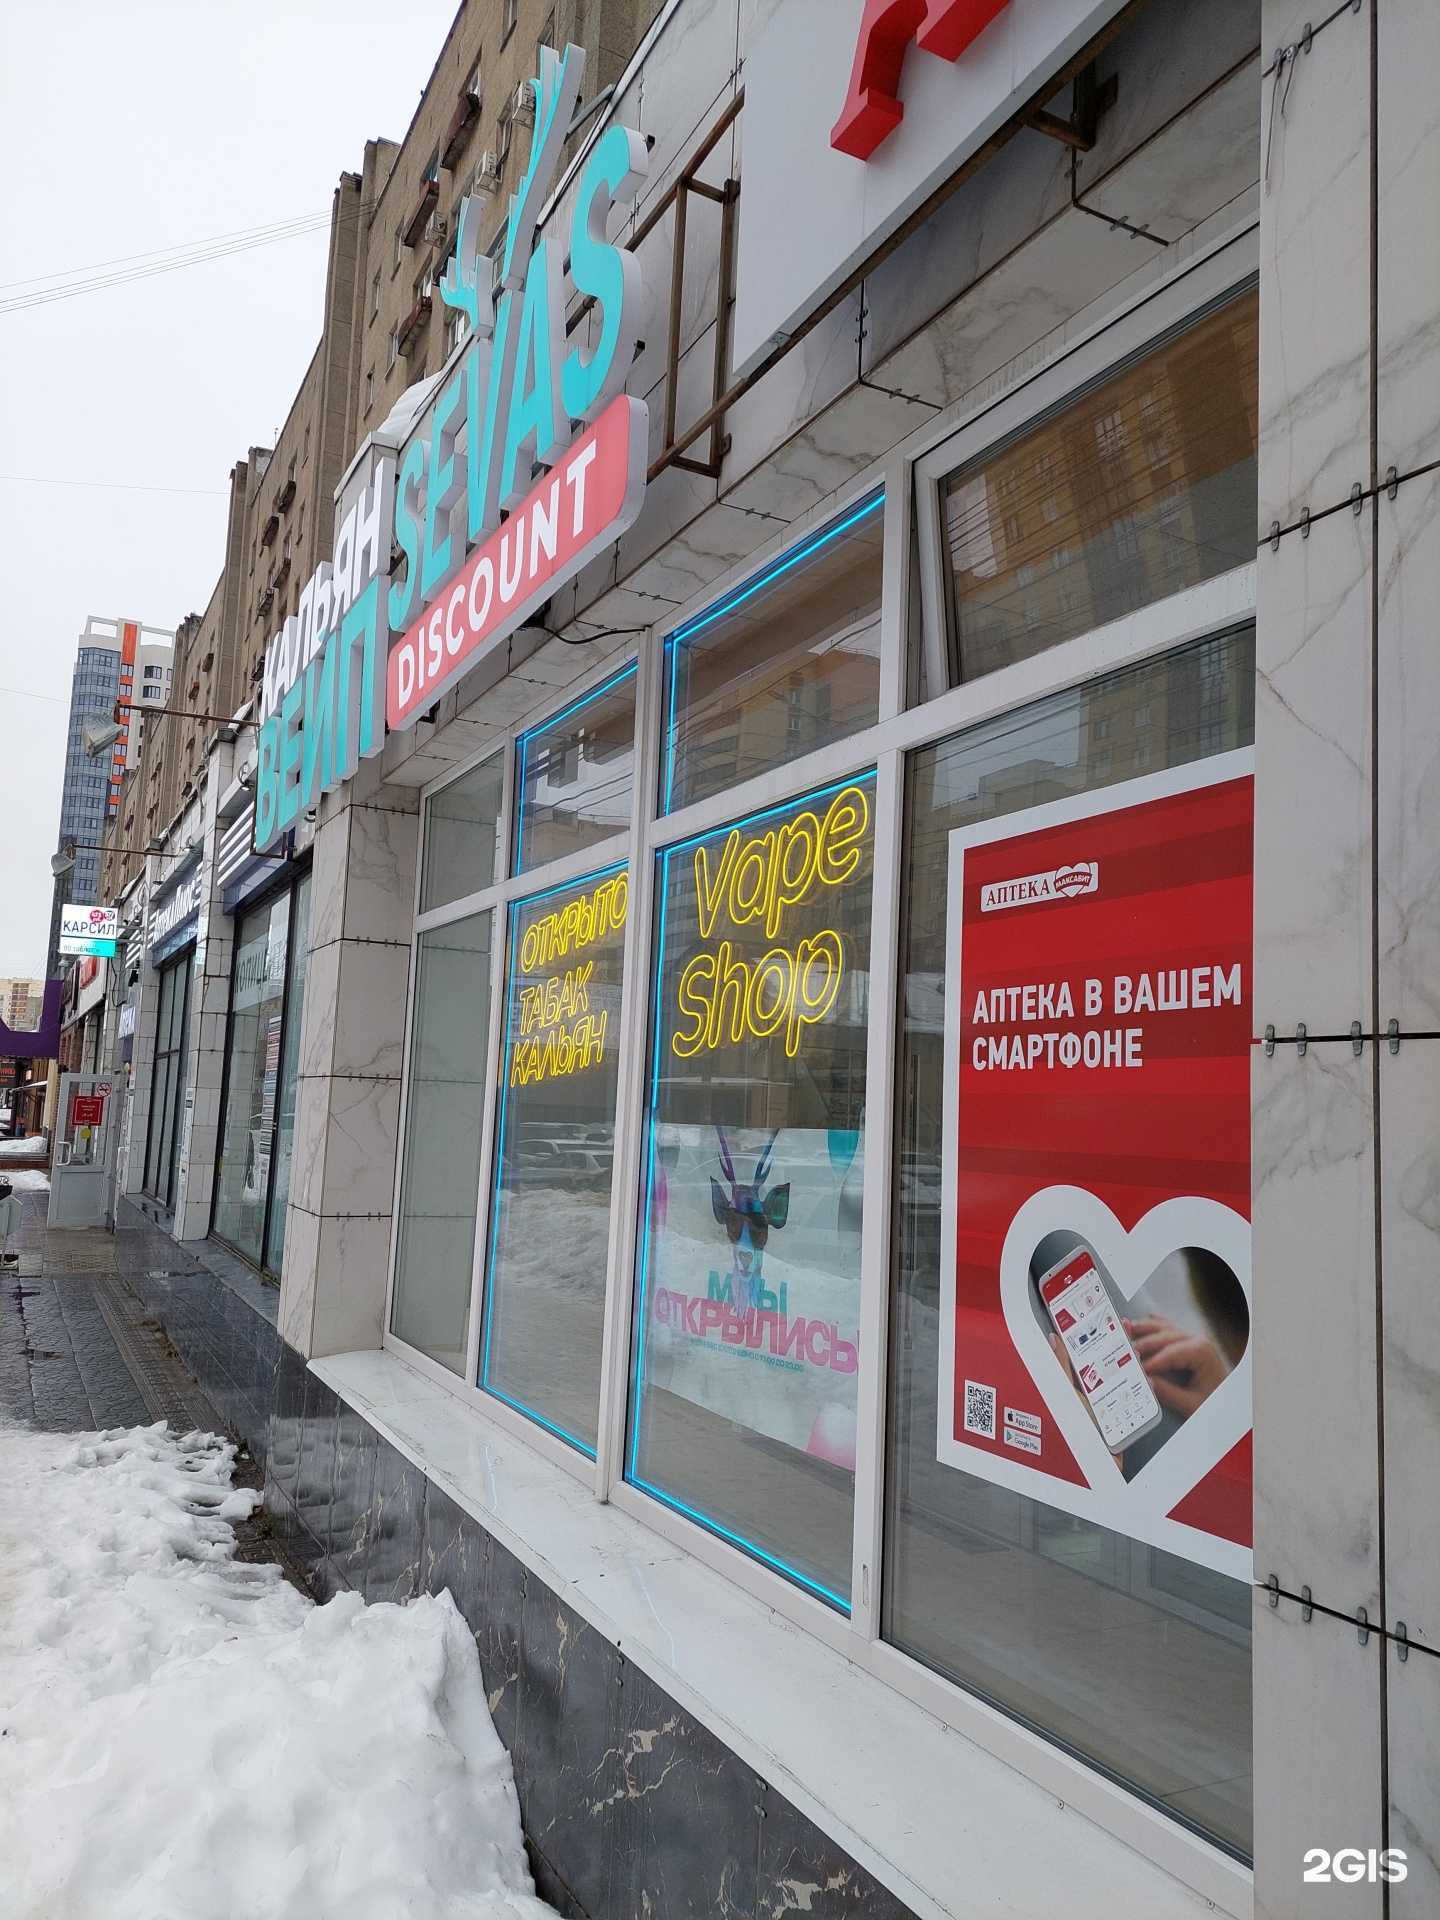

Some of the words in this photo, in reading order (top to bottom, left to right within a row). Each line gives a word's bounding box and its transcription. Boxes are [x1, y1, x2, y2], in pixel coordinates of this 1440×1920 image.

[389, 124, 646, 632] SEVAS
[259, 457, 391, 726] КАЛЬЯН
[397, 438, 599, 710] DISCOUNT
[694, 787, 868, 939] Vape
[986, 878, 1051, 906] АПТЕКА
[63, 920, 115, 935] КАРСИЛ
[520, 872, 629, 973] ОТКРЫТО
[519, 960, 593, 1036] ТАБАК
[972, 981, 1075, 1025] АПТЕКА
[1084, 978, 1103, 1017] В
[1114, 963, 1242, 1015] ВАШЕМ
[510, 1010, 608, 1088] КАЛЬЯН
[972, 1028, 1143, 1071] СМАРТФОНЕ
